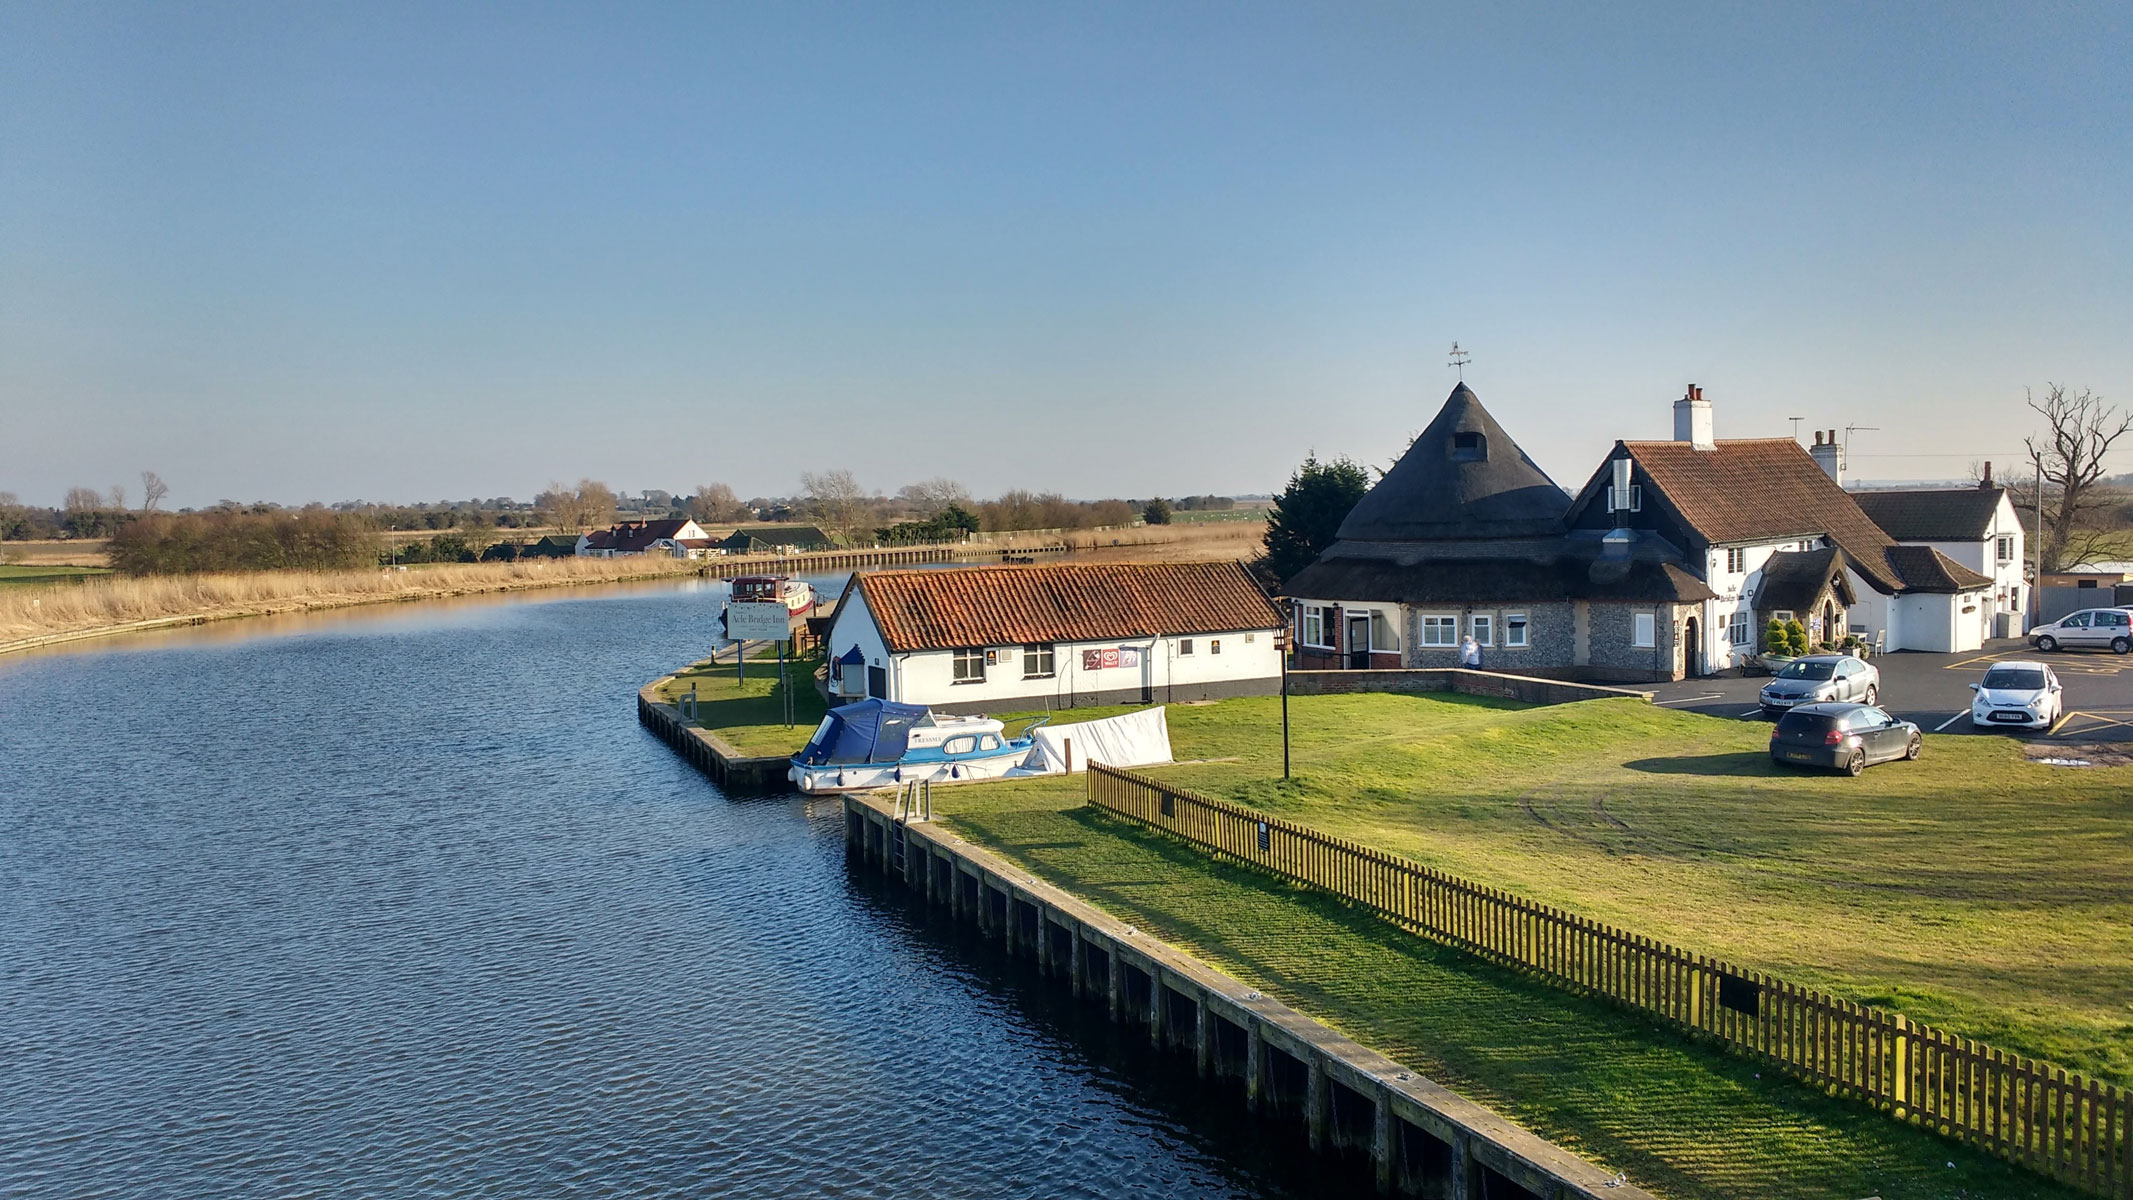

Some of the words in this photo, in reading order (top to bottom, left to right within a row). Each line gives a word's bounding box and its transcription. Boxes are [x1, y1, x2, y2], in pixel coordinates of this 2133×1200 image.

[732, 614, 747, 624] Acle
[748, 614, 771, 625] Bridge
[772, 614, 785, 624] Inn
